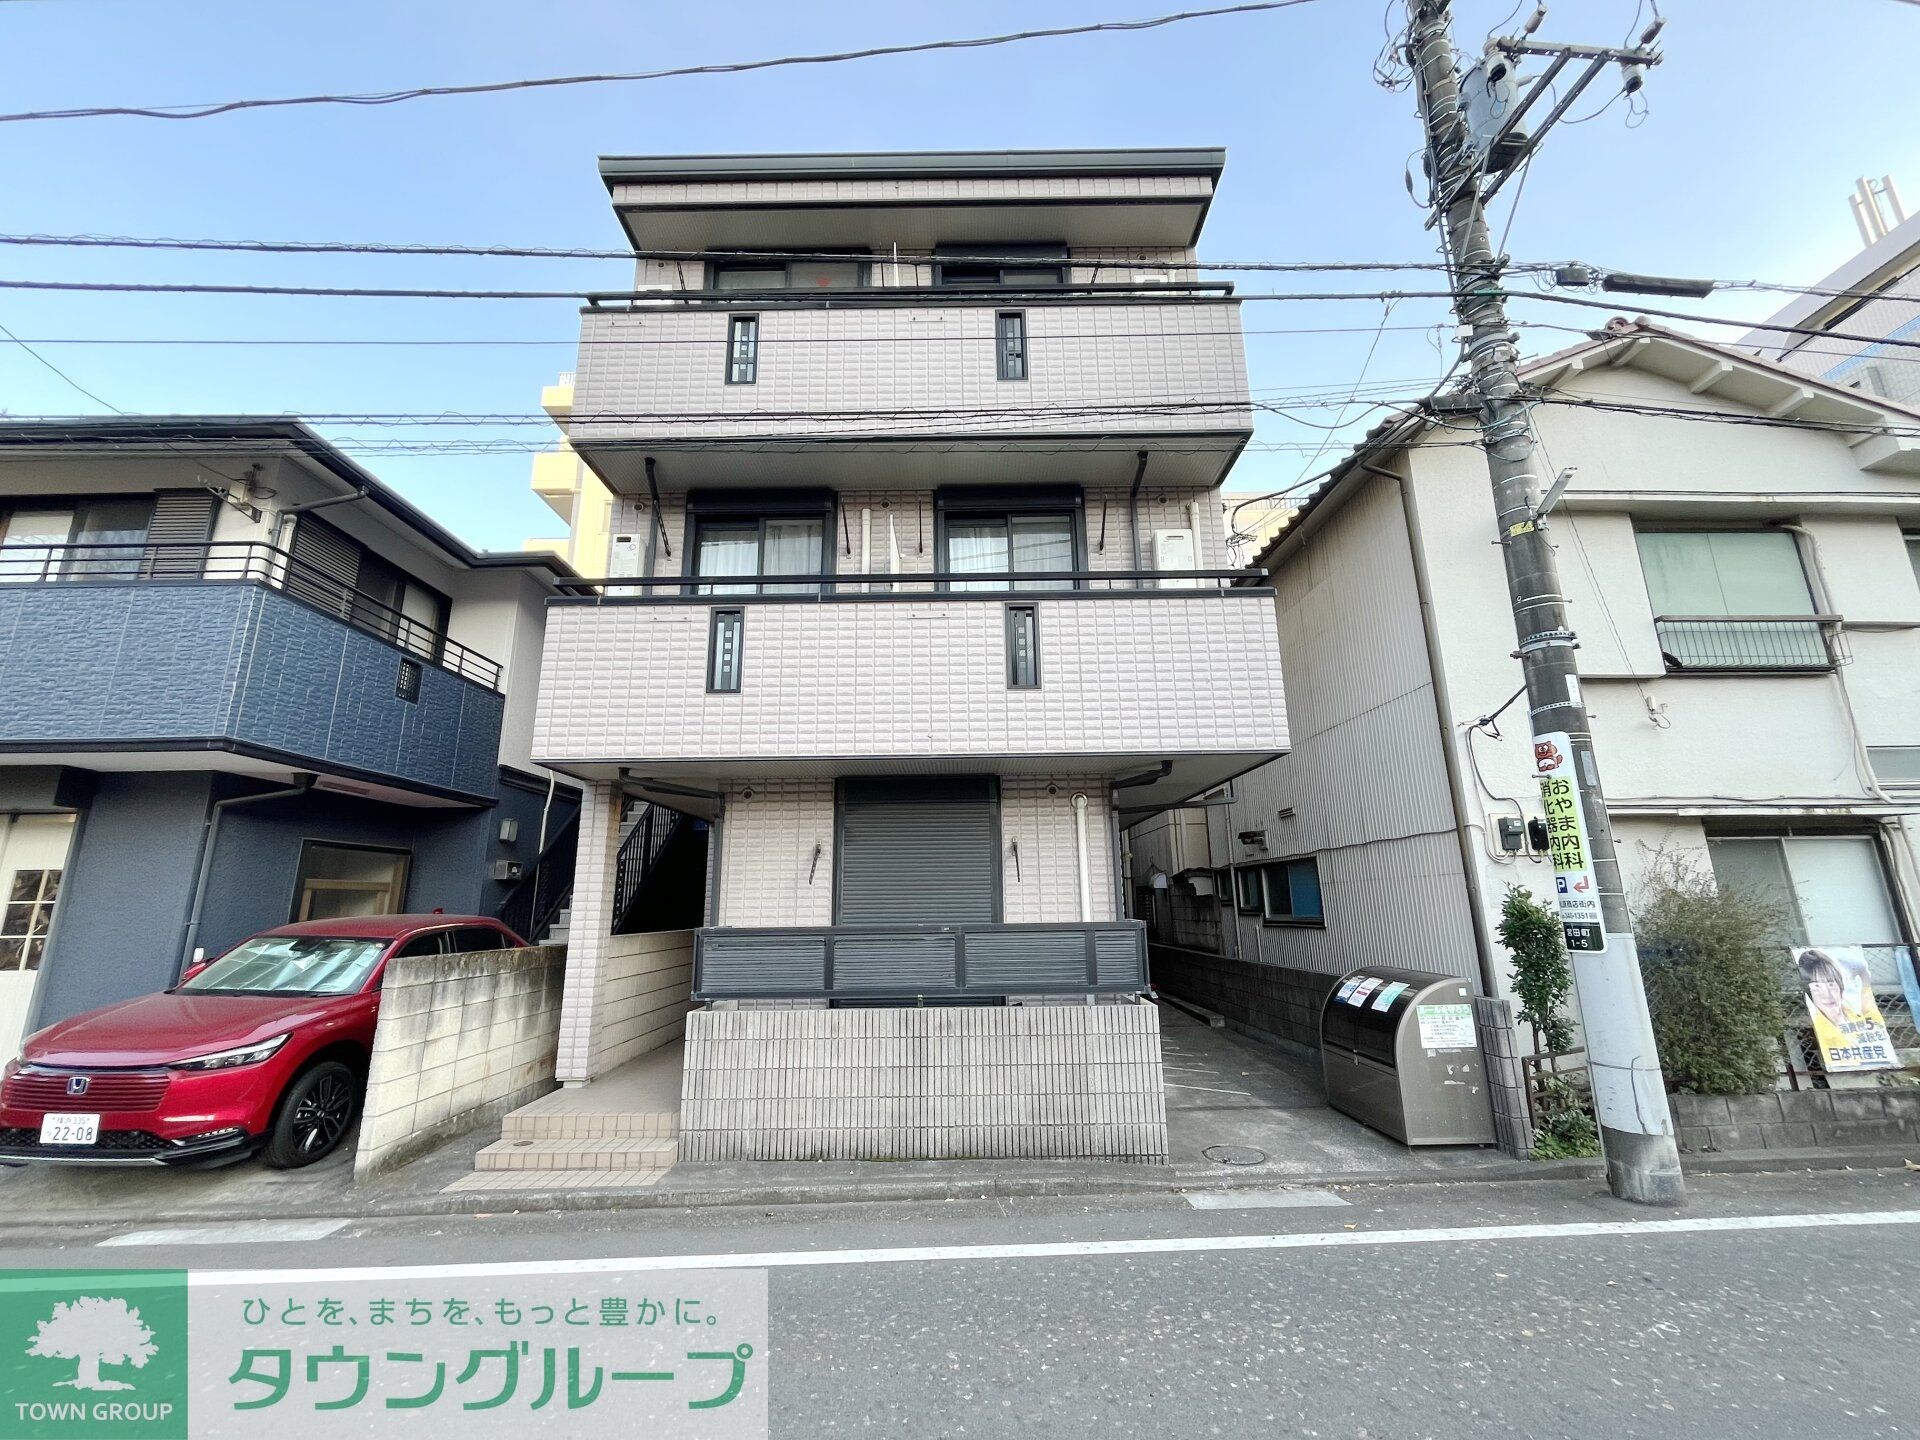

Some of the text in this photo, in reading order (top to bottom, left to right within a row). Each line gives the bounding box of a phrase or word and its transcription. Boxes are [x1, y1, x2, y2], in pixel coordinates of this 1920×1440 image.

[1540, 780, 1564, 869] 消化器内科
[1551, 779, 1584, 868] おやま内科
[1571, 939, 1588, 948] 1-5
[1829, 1045, 1887, 1061] 日本共産党
[52, 1126, 93, 1141] 22-08
